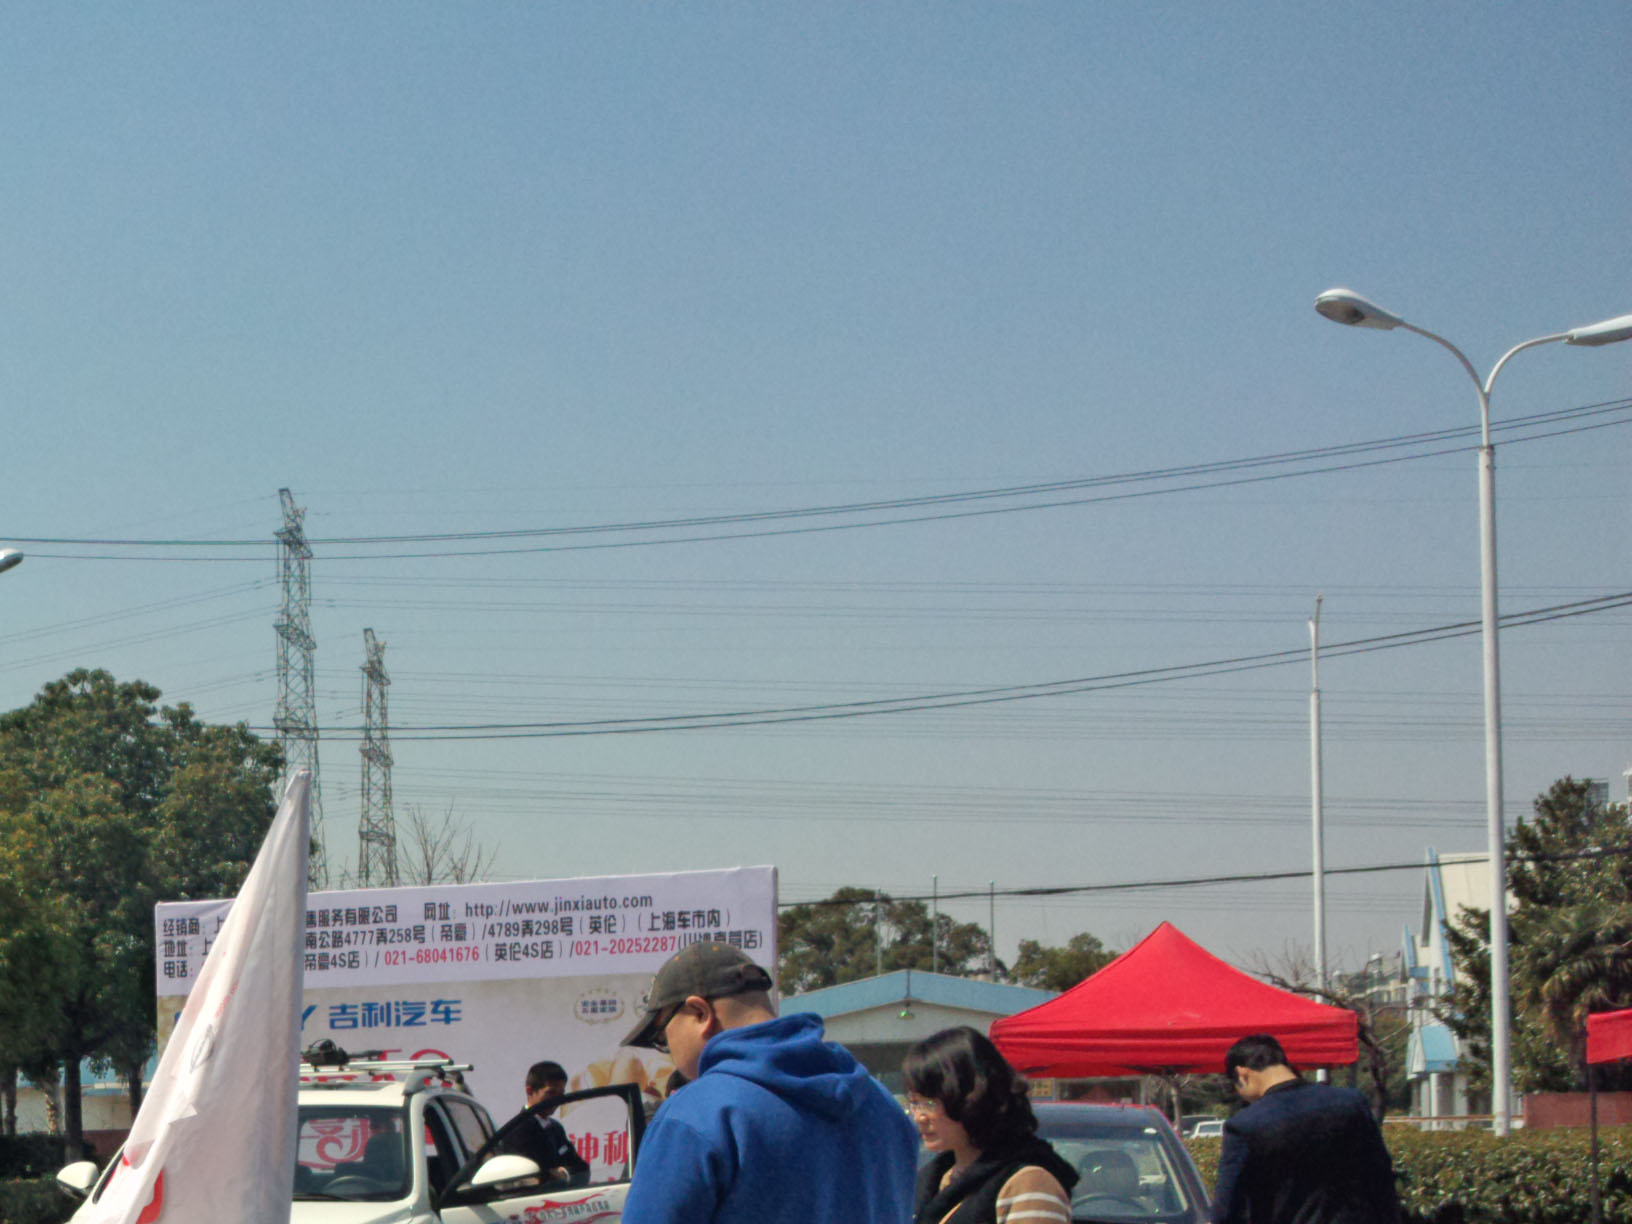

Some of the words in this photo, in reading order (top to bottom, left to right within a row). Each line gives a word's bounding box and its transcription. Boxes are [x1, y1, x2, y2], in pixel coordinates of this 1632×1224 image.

[465, 895, 653, 917] http://www.jinxiauto.com
[329, 999, 462, 1030] 吉利汽车
